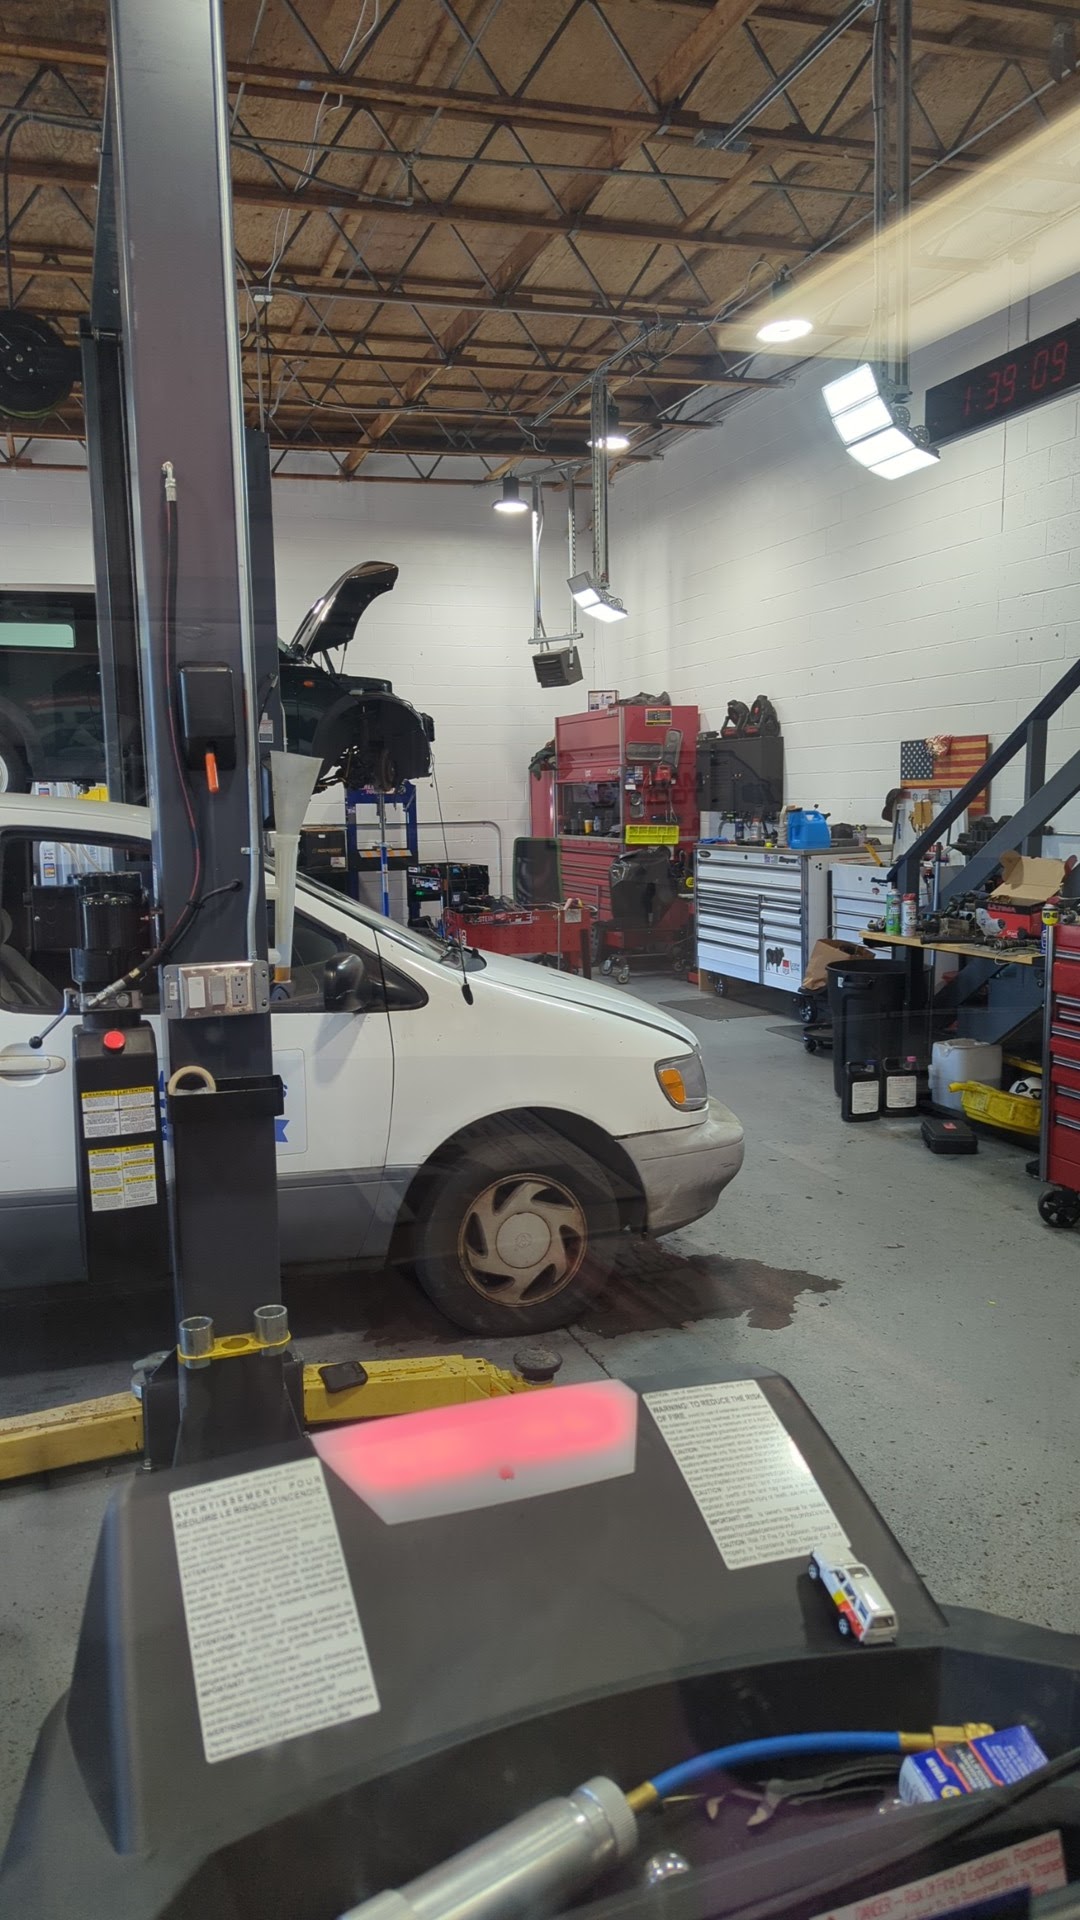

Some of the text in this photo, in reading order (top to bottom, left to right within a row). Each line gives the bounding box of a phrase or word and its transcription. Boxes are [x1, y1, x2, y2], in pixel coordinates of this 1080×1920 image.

[690, 1400, 700, 1408] TO
[700, 1396, 730, 1406] REDUCE
[730, 1394, 745, 1402] THE
[744, 1392, 761, 1400] RISK
[289, 1476, 322, 1489] POUR
[220, 1507, 232, 1519] LE
[234, 1499, 269, 1514] RISQUE
